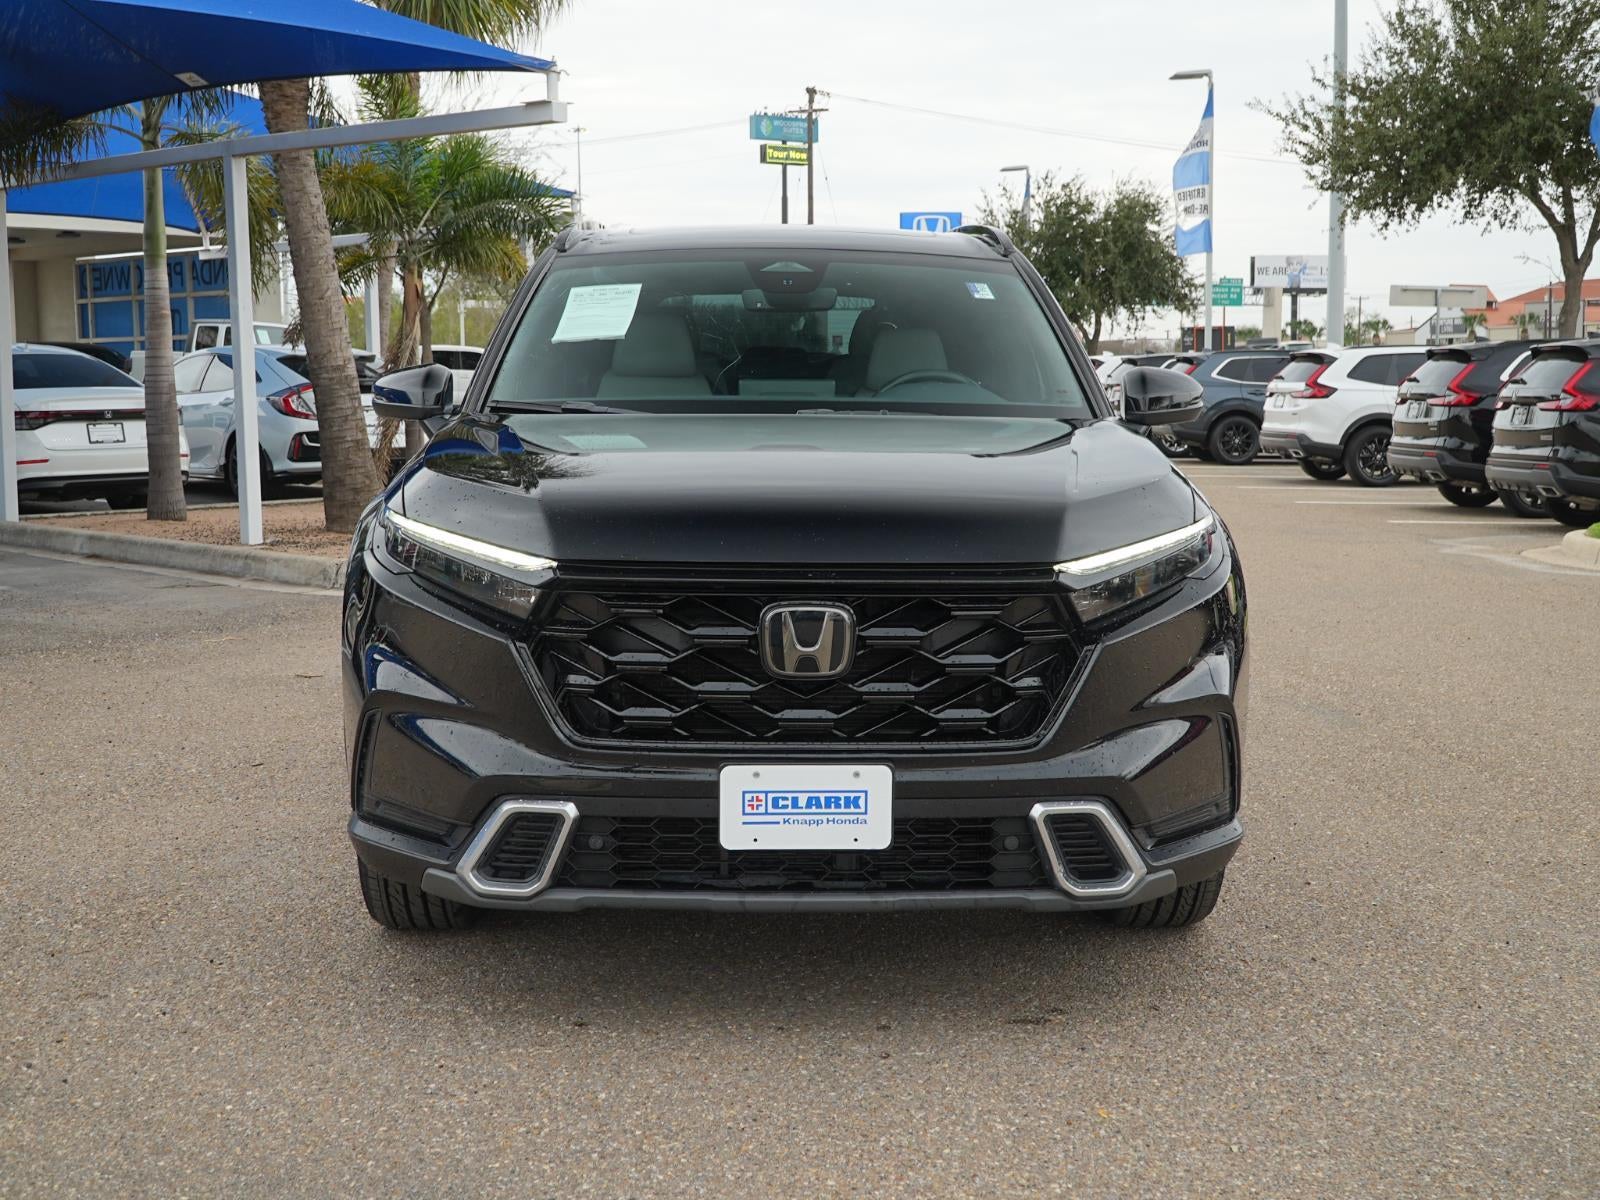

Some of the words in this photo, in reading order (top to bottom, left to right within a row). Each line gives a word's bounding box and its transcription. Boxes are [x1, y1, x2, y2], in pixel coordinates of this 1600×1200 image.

[768, 149, 788, 158] Tour
[790, 151, 807, 160] Now
[1257, 266, 1270, 276] WE
[771, 795, 862, 810] CLARK
[783, 817, 824, 827] Knapp
[826, 817, 867, 825] Honda
